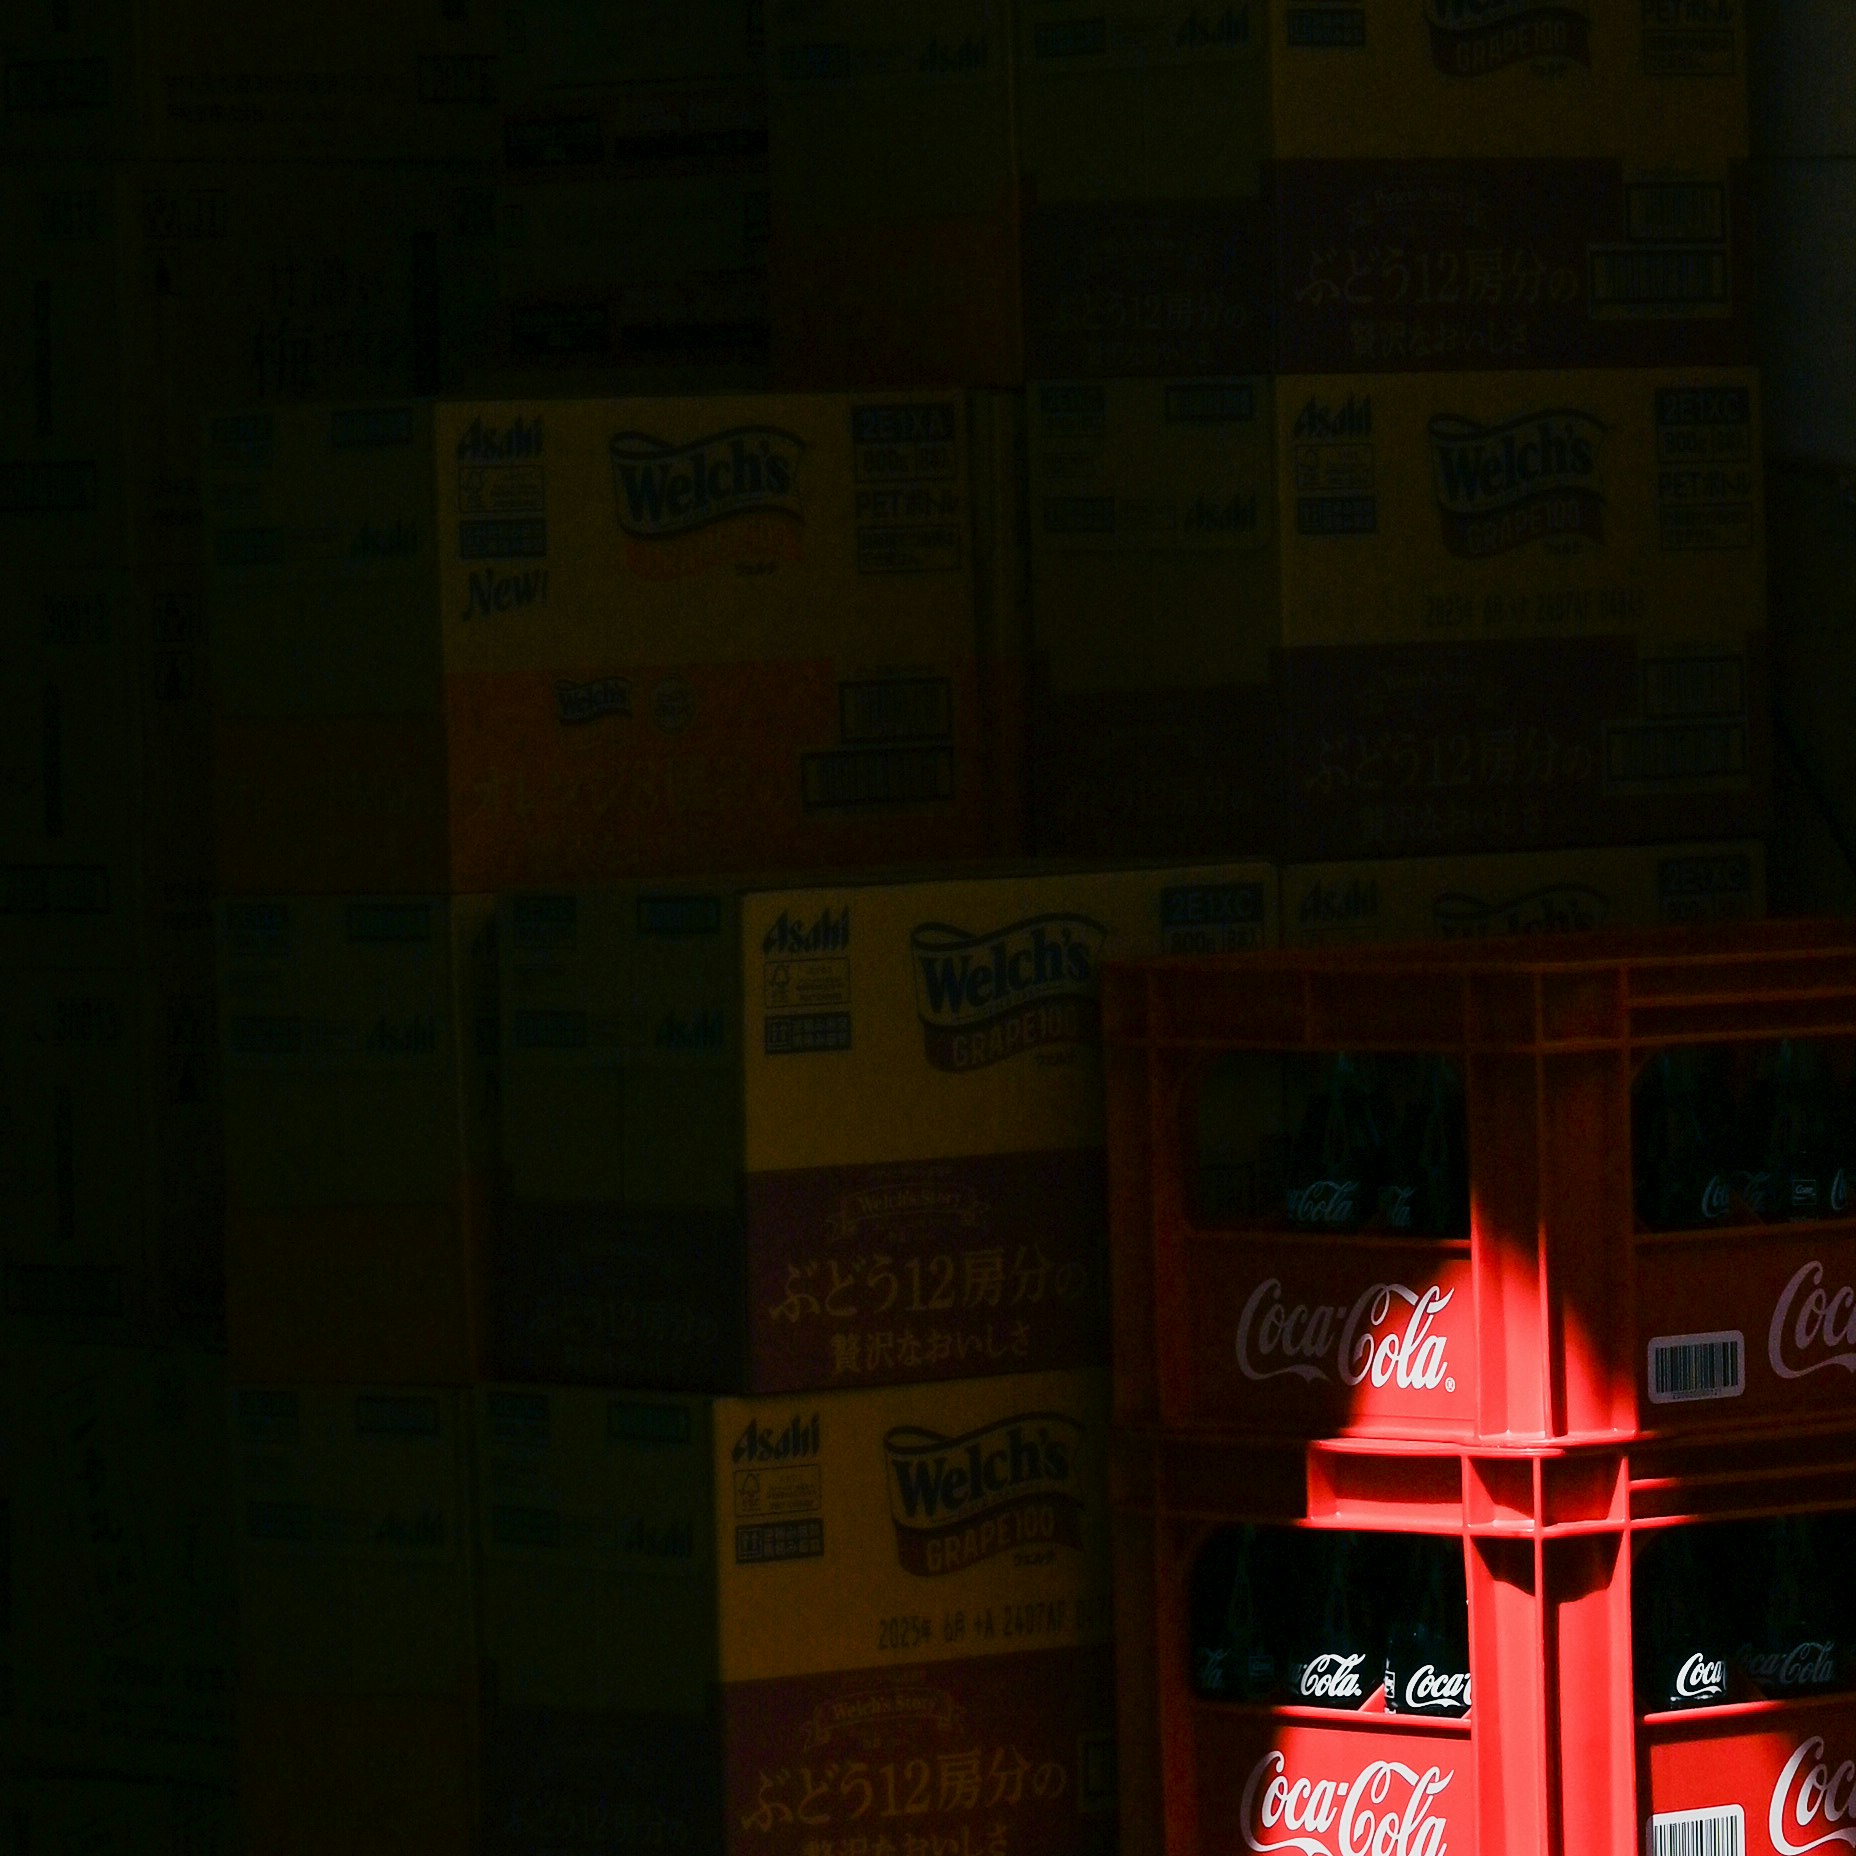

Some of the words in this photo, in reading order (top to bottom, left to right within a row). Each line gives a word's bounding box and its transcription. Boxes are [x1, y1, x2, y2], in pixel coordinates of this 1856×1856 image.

[616, 442, 791, 523] Welch's
[1437, 423, 1594, 501] Welch's
[919, 928, 1091, 1015] Welch's
[768, 1243, 1087, 1323] ぶどう12房分の
[1236, 1277, 1455, 1392] Coca-Cola
[893, 1428, 1068, 1519] Welch's
[740, 1745, 1067, 1834] ぶどう12房分の
